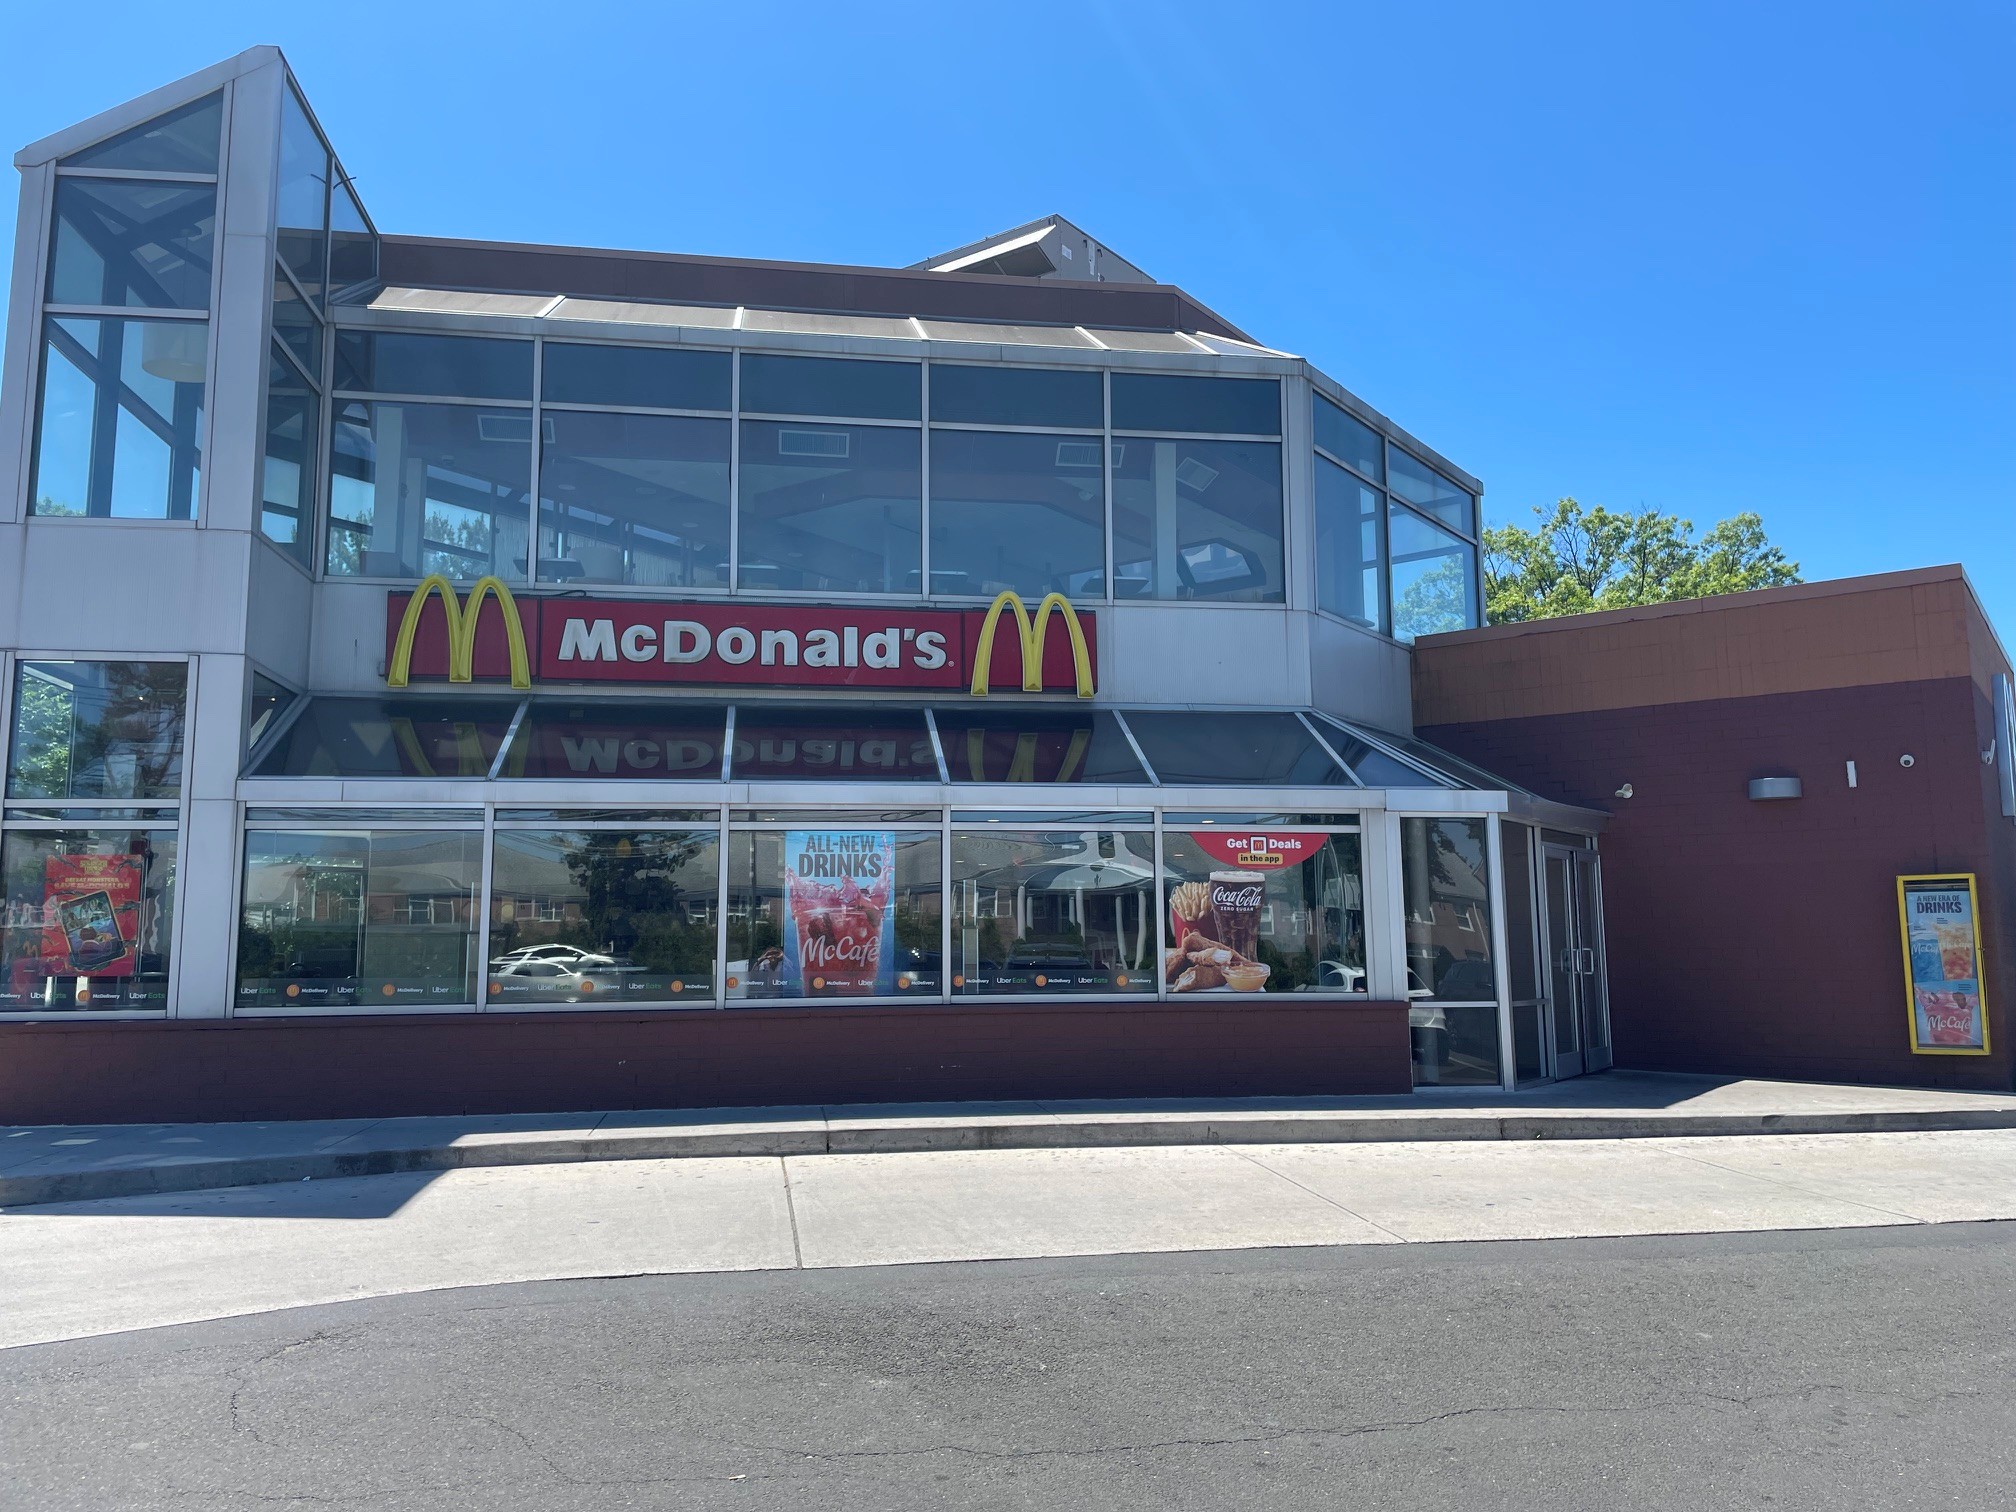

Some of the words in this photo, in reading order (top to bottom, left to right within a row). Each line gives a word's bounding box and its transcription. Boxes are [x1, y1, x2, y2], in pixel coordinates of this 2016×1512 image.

[557, 618, 948, 670] McDonald's
[805, 834, 876, 854] ALL-NEW
[1226, 838, 1248, 849] Get
[1269, 838, 1302, 849] Deals
[799, 853, 882, 879] DRINKS
[1240, 854, 1249, 862] in
[1249, 854, 1263, 862] the
[1264, 856, 1280, 864] app
[1212, 886, 1263, 907] Coca-Cola
[1916, 901, 1963, 914] DRINKS
[801, 935, 881, 968] McCafé
[1928, 1015, 1971, 1031] McCafé
